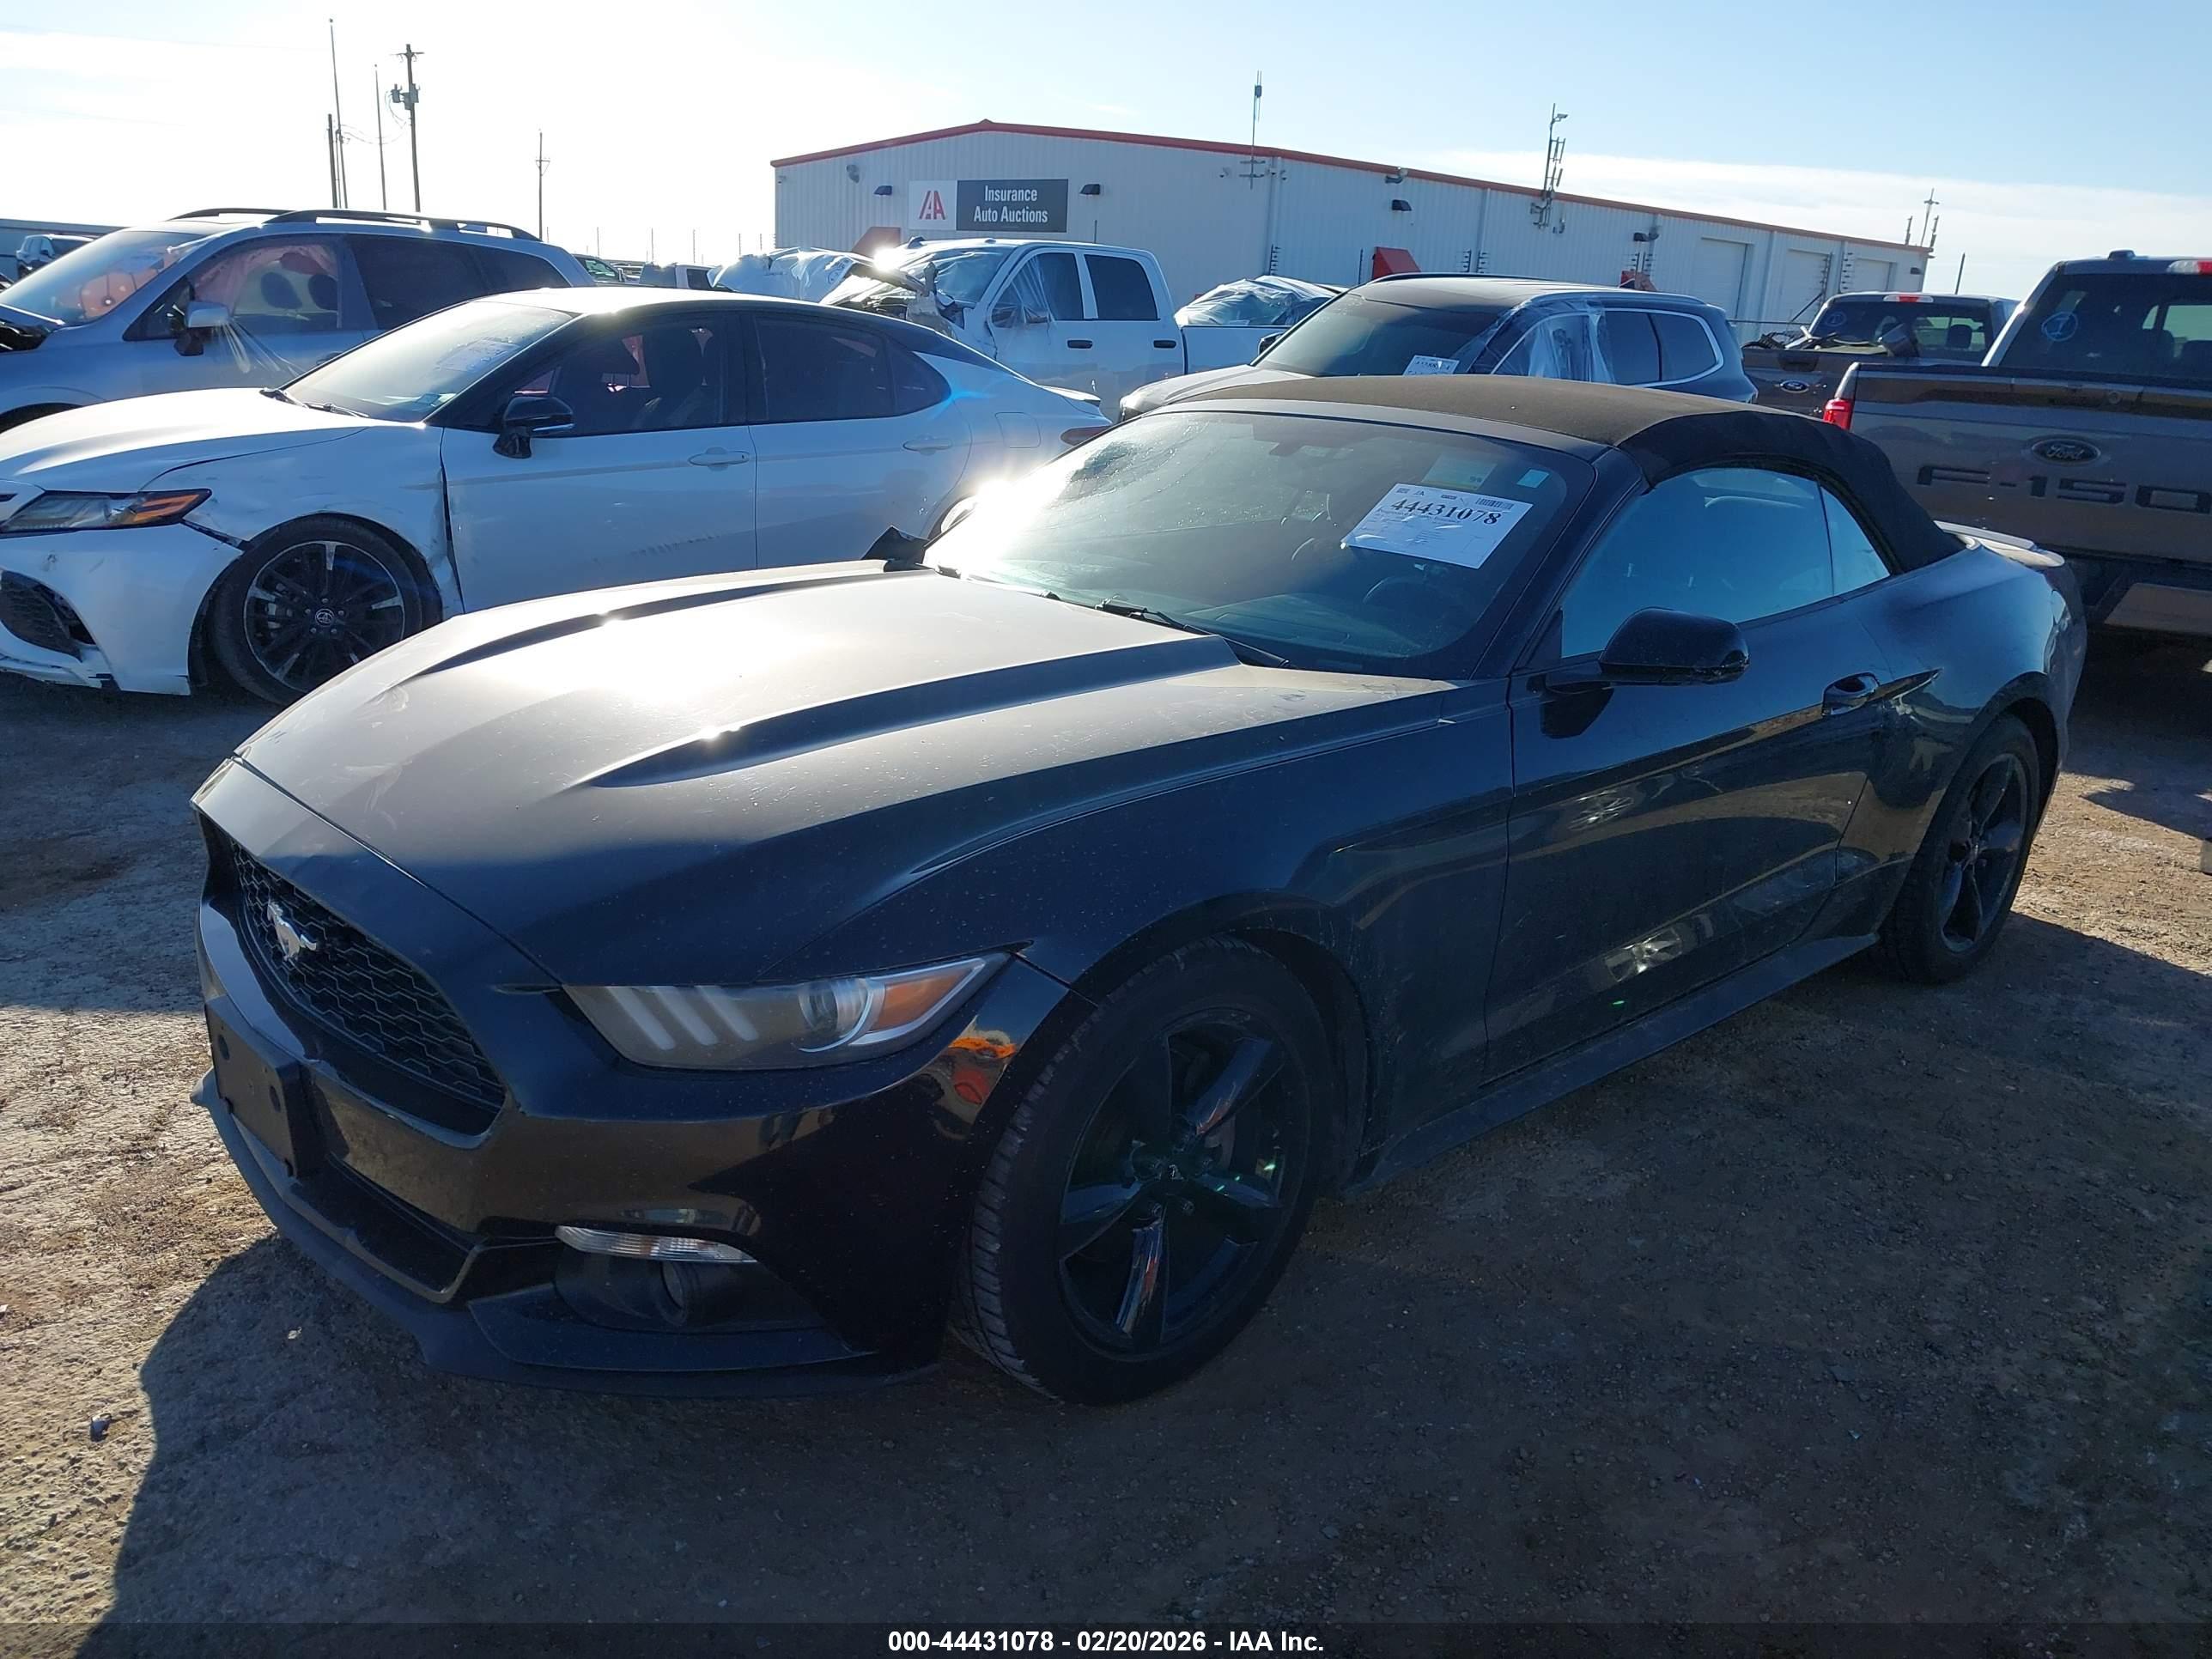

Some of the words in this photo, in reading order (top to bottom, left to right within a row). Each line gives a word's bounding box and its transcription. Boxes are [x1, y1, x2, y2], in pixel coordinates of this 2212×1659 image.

[984, 185, 1038, 203] Insurance
[974, 206, 998, 223] Auto
[1000, 206, 1048, 223] Auctions
[2046, 444, 2086, 460] Ford
[1916, 465, 2212, 514] F-150
[1391, 498, 1502, 525] 44431078
